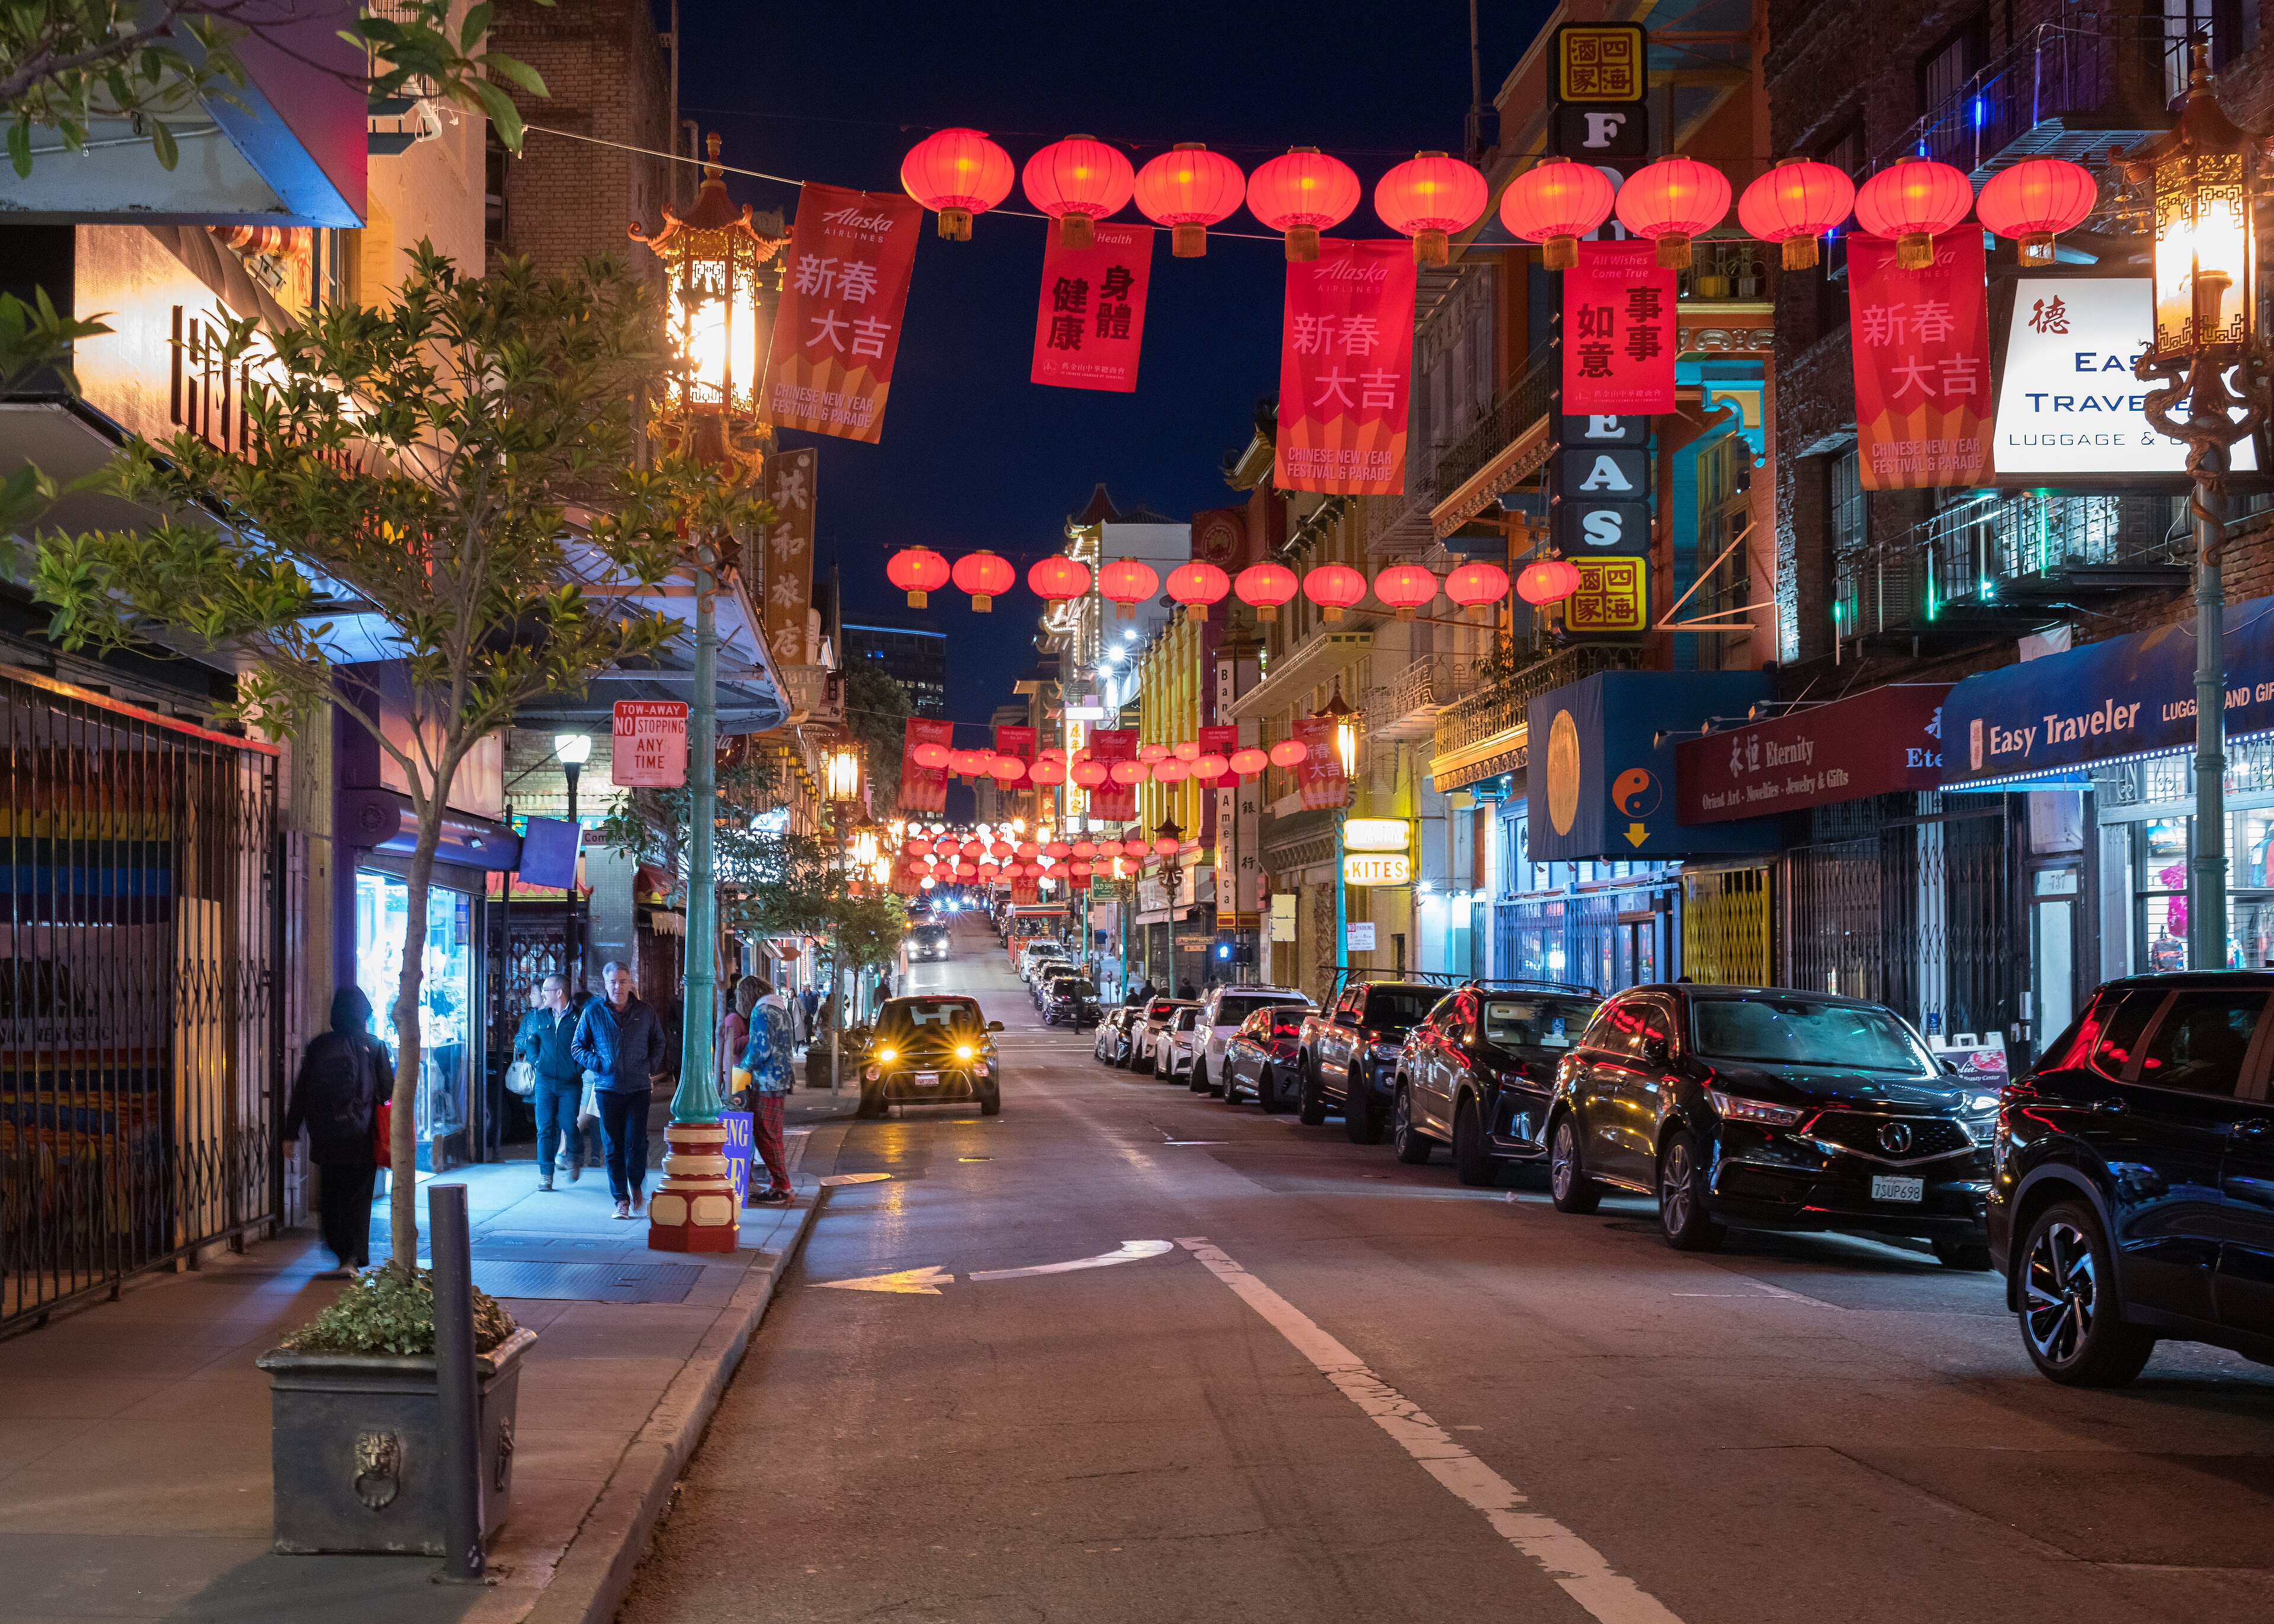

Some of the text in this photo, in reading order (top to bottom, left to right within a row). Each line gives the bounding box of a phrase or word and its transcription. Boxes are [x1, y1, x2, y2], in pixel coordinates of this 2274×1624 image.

[822, 208, 894, 233] Alaska
[824, 227, 884, 243] AIRLINES
[1097, 233, 1132, 245] Health
[1313, 259, 1389, 284] Alaska
[1592, 256, 1647, 265] All Wishes
[1592, 268, 1649, 278] Come True
[794, 254, 878, 304] 新春
[1883, 270, 1950, 281] AIRLINES
[1318, 285, 1381, 294] AIRLINES
[1046, 276, 1089, 351] 健康
[1096, 265, 1135, 340] 身體
[2028, 295, 2070, 334] 德
[805, 310, 891, 359] 大吉
[1292, 313, 1380, 356] 新春
[1624, 286, 1663, 362] 事事
[1862, 300, 1955, 348] 新春
[1577, 303, 1614, 378] 如意
[2075, 353, 2145, 372] EAS
[1312, 366, 1400, 410] 大吉
[1891, 352, 1980, 400] 大吉
[775, 383, 874, 413] CHINESE NEW YEAR
[2025, 393, 2193, 413] TRAVEE
[772, 398, 872, 429] FESTIVAL & PARADE
[1872, 437, 1981, 458] CHINESE NEW YEAR
[2009, 435, 2125, 446] LUGGAGE
[2141, 432, 2155, 446] &
[1289, 447, 1392, 465] CHINESE NEW YEAR
[1872, 454, 1983, 474] FESTIVAL & PARADE
[1287, 463, 1392, 481] FESTIVAL & PARADE
[1579, 414, 1633, 547] EAS
[621, 704, 682, 715] TOW-AWAY
[2162, 682, 2274, 722] LUGG AND GIF
[615, 718, 684, 735] NO STOPPING
[1990, 725, 2037, 757] Easy
[2044, 699, 2141, 744] Traveler
[637, 739, 663, 752] ANY
[1765, 735, 1814, 767] Eternity
[635, 754, 664, 769] TIME
[1703, 768, 1849, 810] Orient Art Novelties Jewelry & Gifts
[1220, 795, 1231, 904] America
[1353, 861, 1403, 877] KITES
[2050, 874, 2066, 890] 737
[1874, 1184, 1920, 1199] 7SUP698
